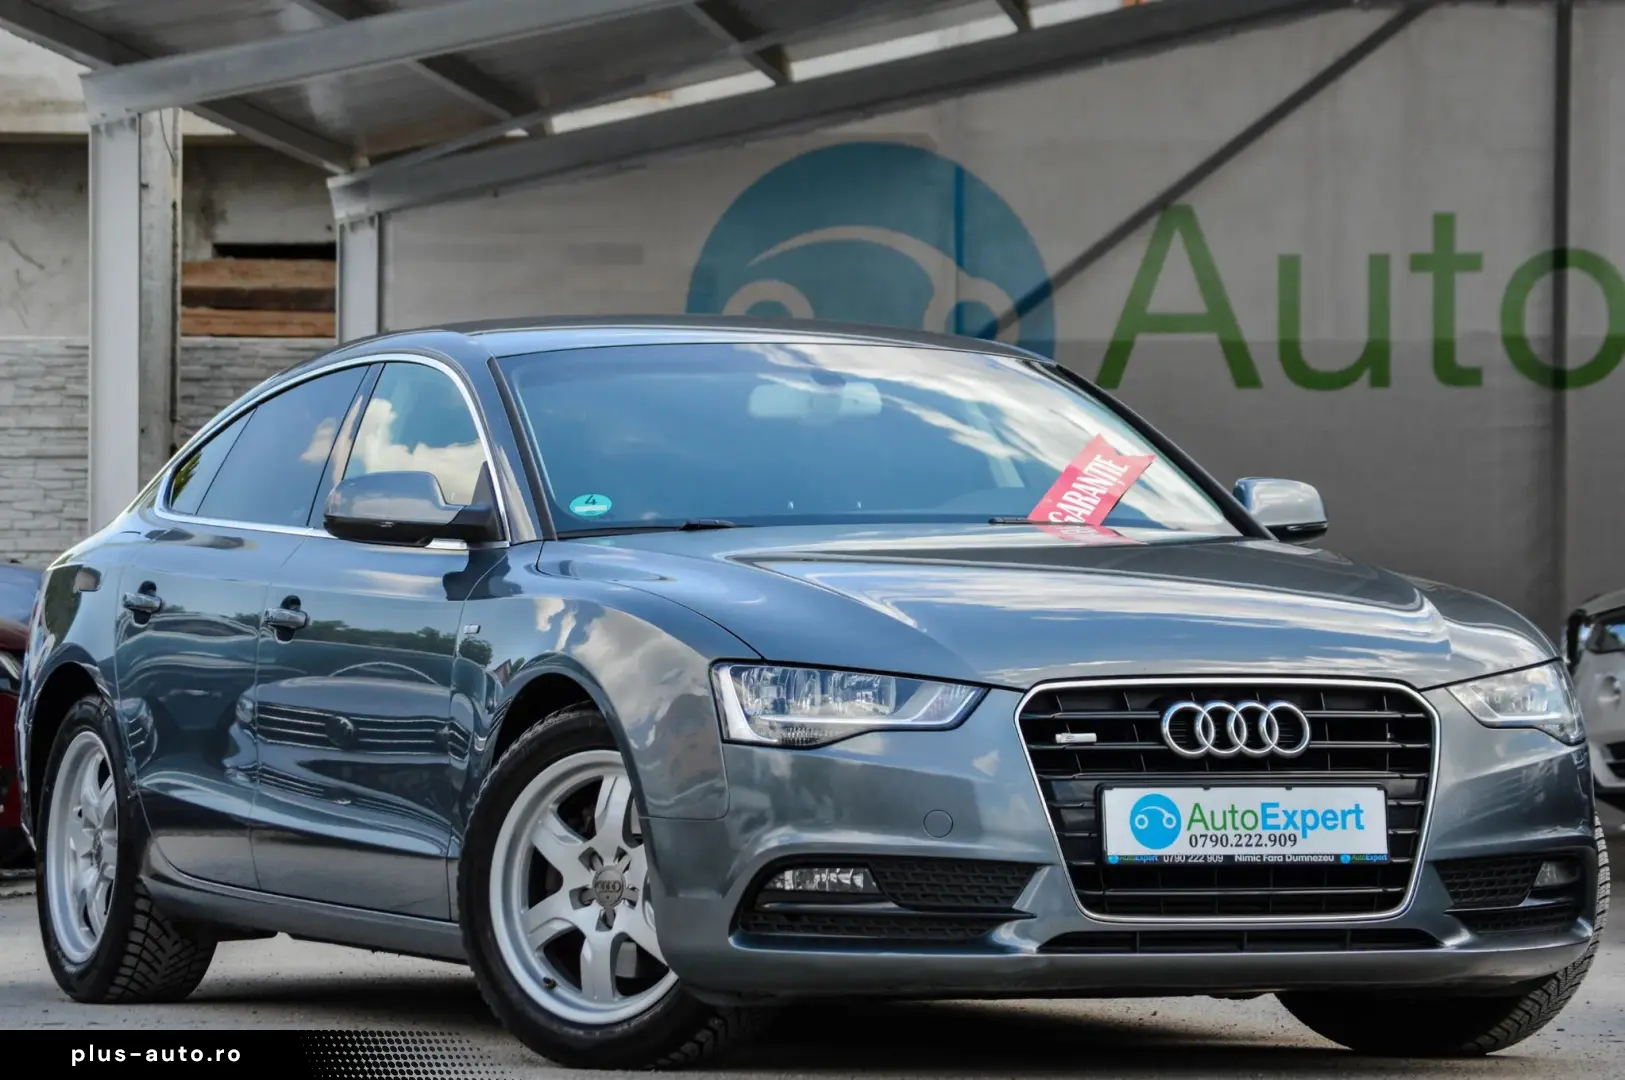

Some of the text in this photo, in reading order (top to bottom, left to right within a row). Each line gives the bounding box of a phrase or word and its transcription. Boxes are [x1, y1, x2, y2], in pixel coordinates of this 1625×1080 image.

[1096, 204, 1625, 391] Auto
[585, 495, 597, 505] 4
[1186, 801, 1365, 839] AutoExpert
[1189, 833, 1298, 848] 0790.222.909
[1163, 854, 1186, 863] 0790
[1188, 854, 1205, 863] 222
[1207, 854, 1224, 863] 909
[1235, 854, 1262, 863] Nimic
[1263, 854, 1284, 863] Fara
[1285, 854, 1335, 863] Dumnezeu
[1351, 854, 1389, 863] AutoExpert
